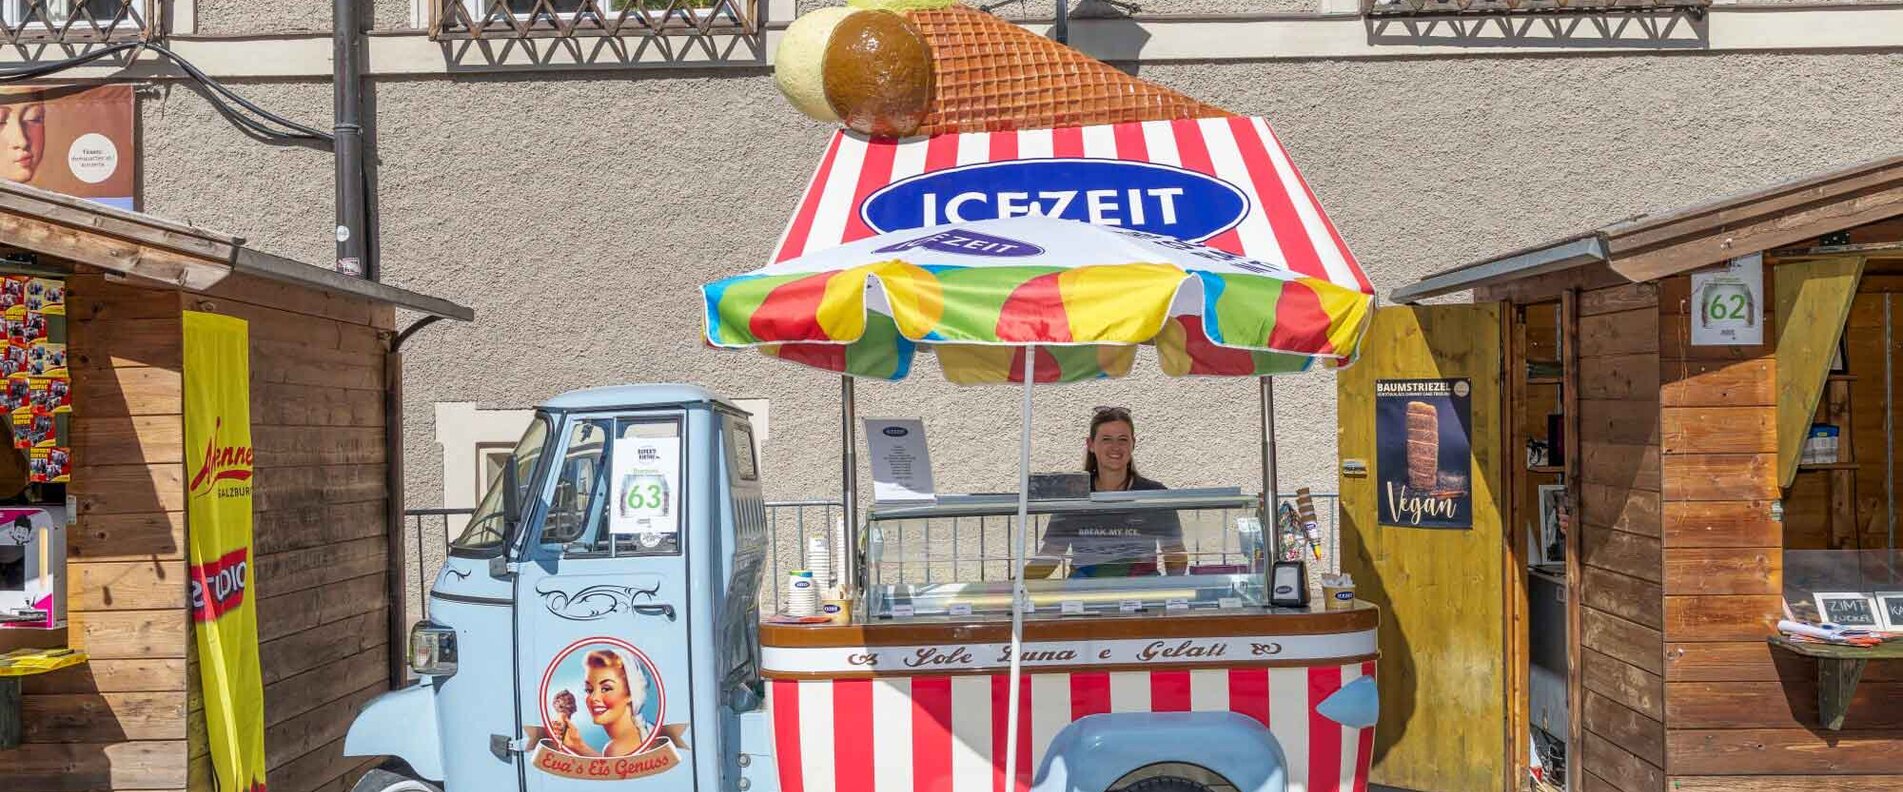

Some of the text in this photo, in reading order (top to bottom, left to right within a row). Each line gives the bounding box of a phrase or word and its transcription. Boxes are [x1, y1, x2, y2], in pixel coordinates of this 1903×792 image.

[1710, 294, 1746, 320] 62
[1376, 382, 1451, 392] BAUMSTRIEZEL
[627, 484, 661, 509] 63
[1386, 481, 1457, 526] Vegan
[903, 646, 973, 667] Sole
[1098, 647, 1112, 659] e
[541, 752, 669, 776] Eva's Eis Genuss
